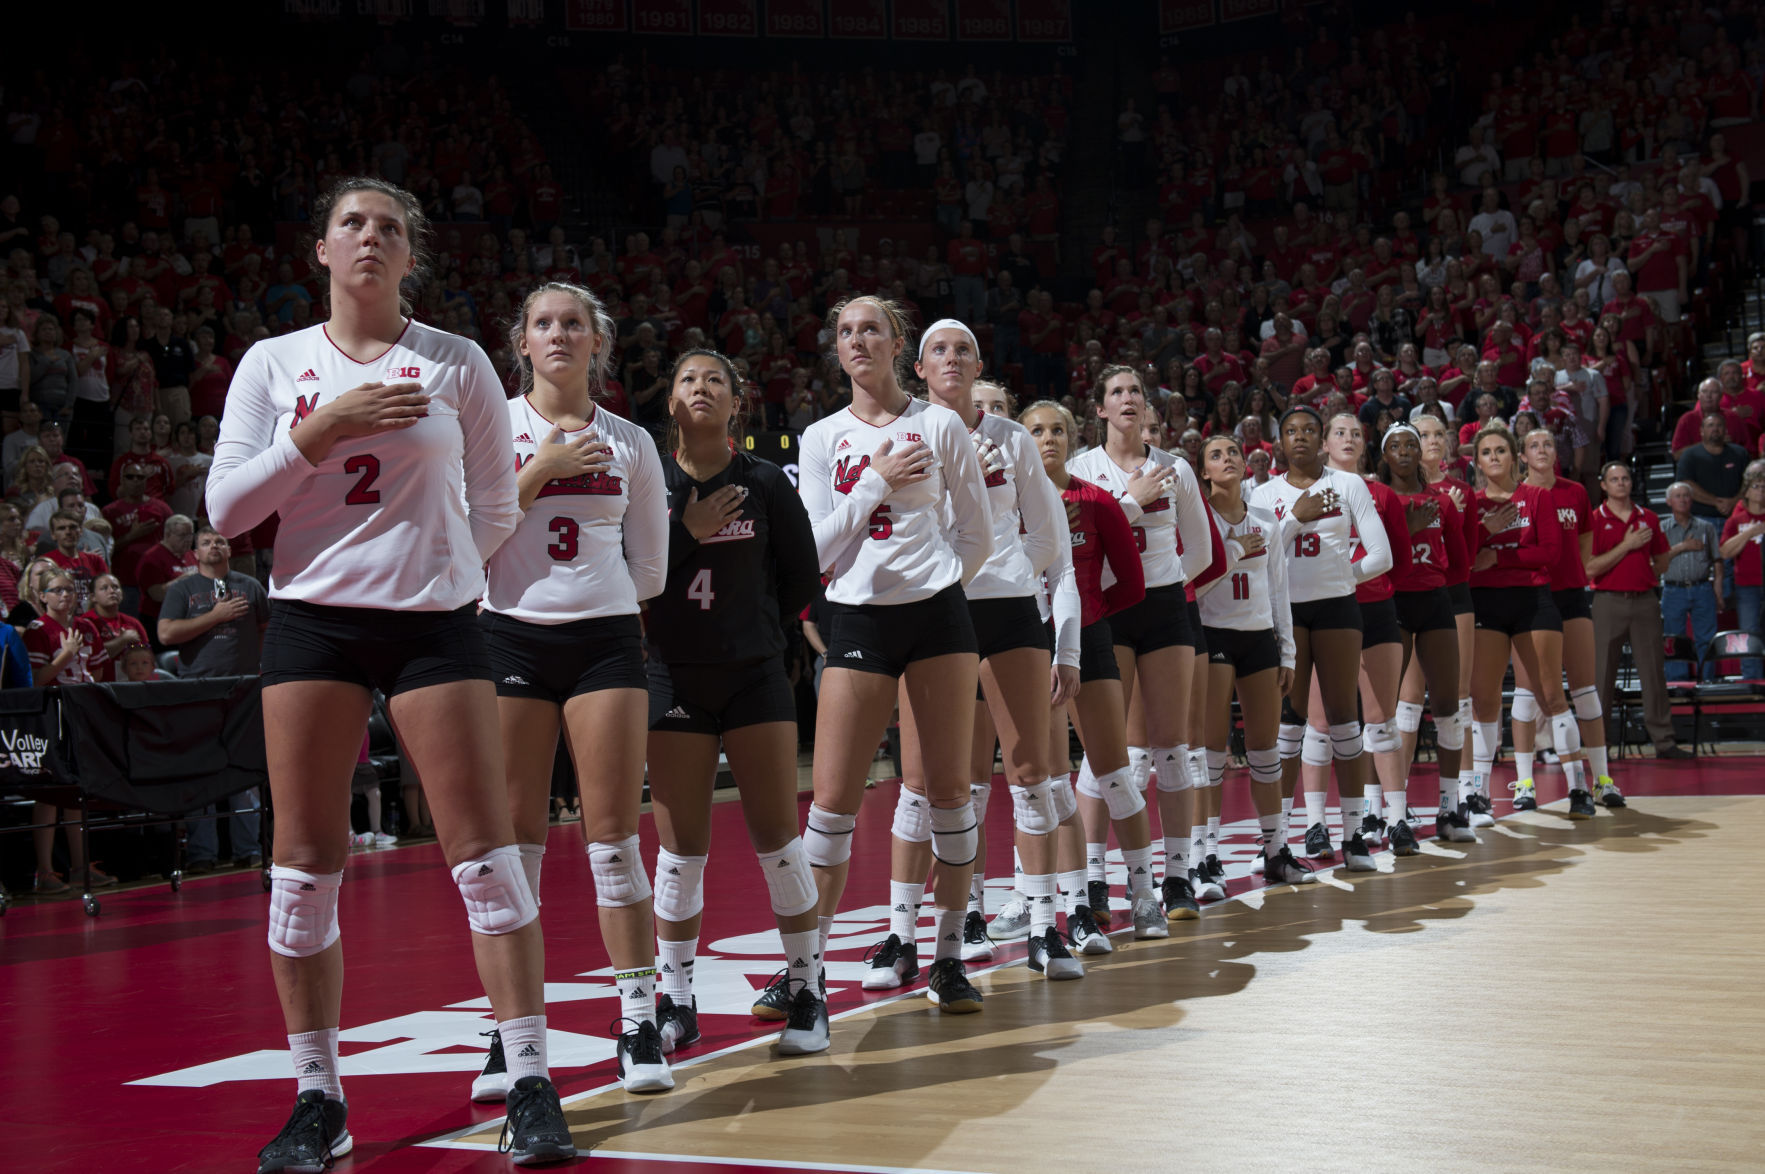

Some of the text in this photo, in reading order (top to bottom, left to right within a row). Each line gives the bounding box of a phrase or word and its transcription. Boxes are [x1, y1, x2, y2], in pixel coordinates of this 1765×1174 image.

[639, 12, 687, 28] 1981
[704, 13, 749, 30] 1982
[772, 15, 817, 31] 1983
[834, 17, 880, 33] 1984
[898, 18, 944, 35] 1985
[963, 18, 1007, 34] 1986
[1023, 19, 1067, 36] 1987
[344, 453, 380, 506] 2
[869, 504, 893, 540] 5
[548, 516, 580, 561] 3
[1294, 533, 1321, 558] 13
[687, 568, 716, 610] 4
[1231, 573, 1250, 600] 11
[0, 728, 49, 757] Volley
[0, 751, 43, 768] CART
